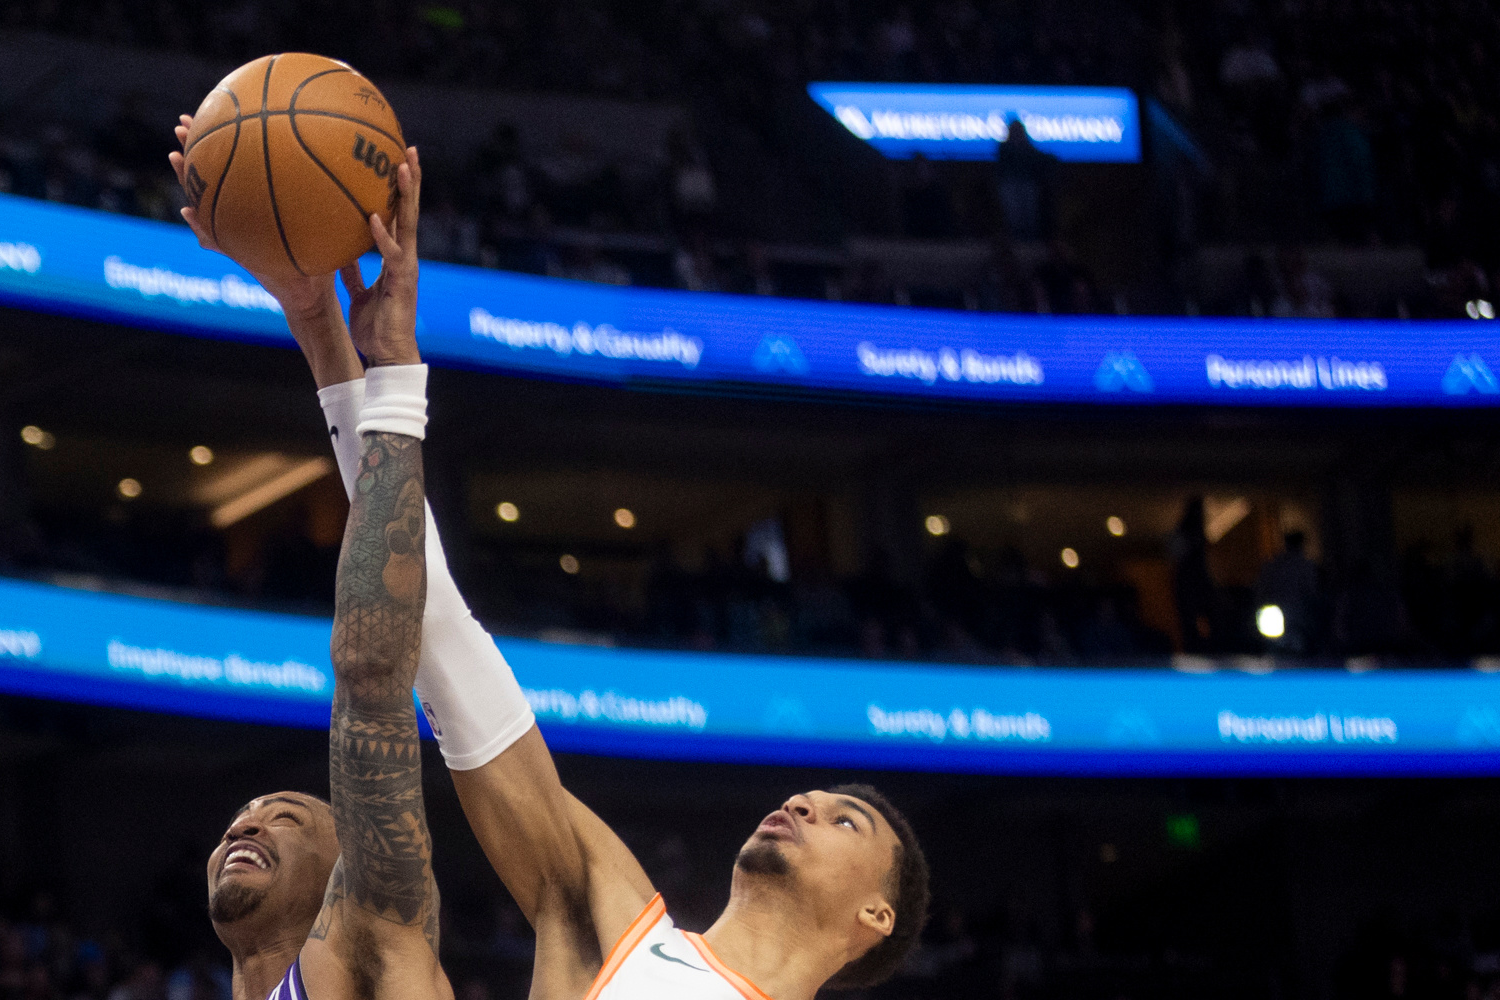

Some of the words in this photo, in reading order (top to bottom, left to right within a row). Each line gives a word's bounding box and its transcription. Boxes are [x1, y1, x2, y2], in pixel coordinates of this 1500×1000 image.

[103, 254, 221, 306] Employee
[469, 307, 573, 359] Property
[572, 321, 595, 356] &
[593, 323, 702, 369] Casualty
[857, 340, 938, 386] Surety
[937, 346, 961, 382] &
[960, 348, 1045, 387] Bonds
[1204, 353, 1317, 389] Personal
[1316, 354, 1388, 391] Lines
[106, 637, 224, 686] Employee
[223, 653, 328, 692] Benefits
[578, 689, 601, 721] &
[600, 688, 708, 733] Casualty
[867, 702, 948, 744] Surety
[947, 706, 971, 741] &
[970, 707, 1053, 744] Bonds
[1217, 708, 1329, 744] Personal
[1328, 710, 1399, 745] Lines
